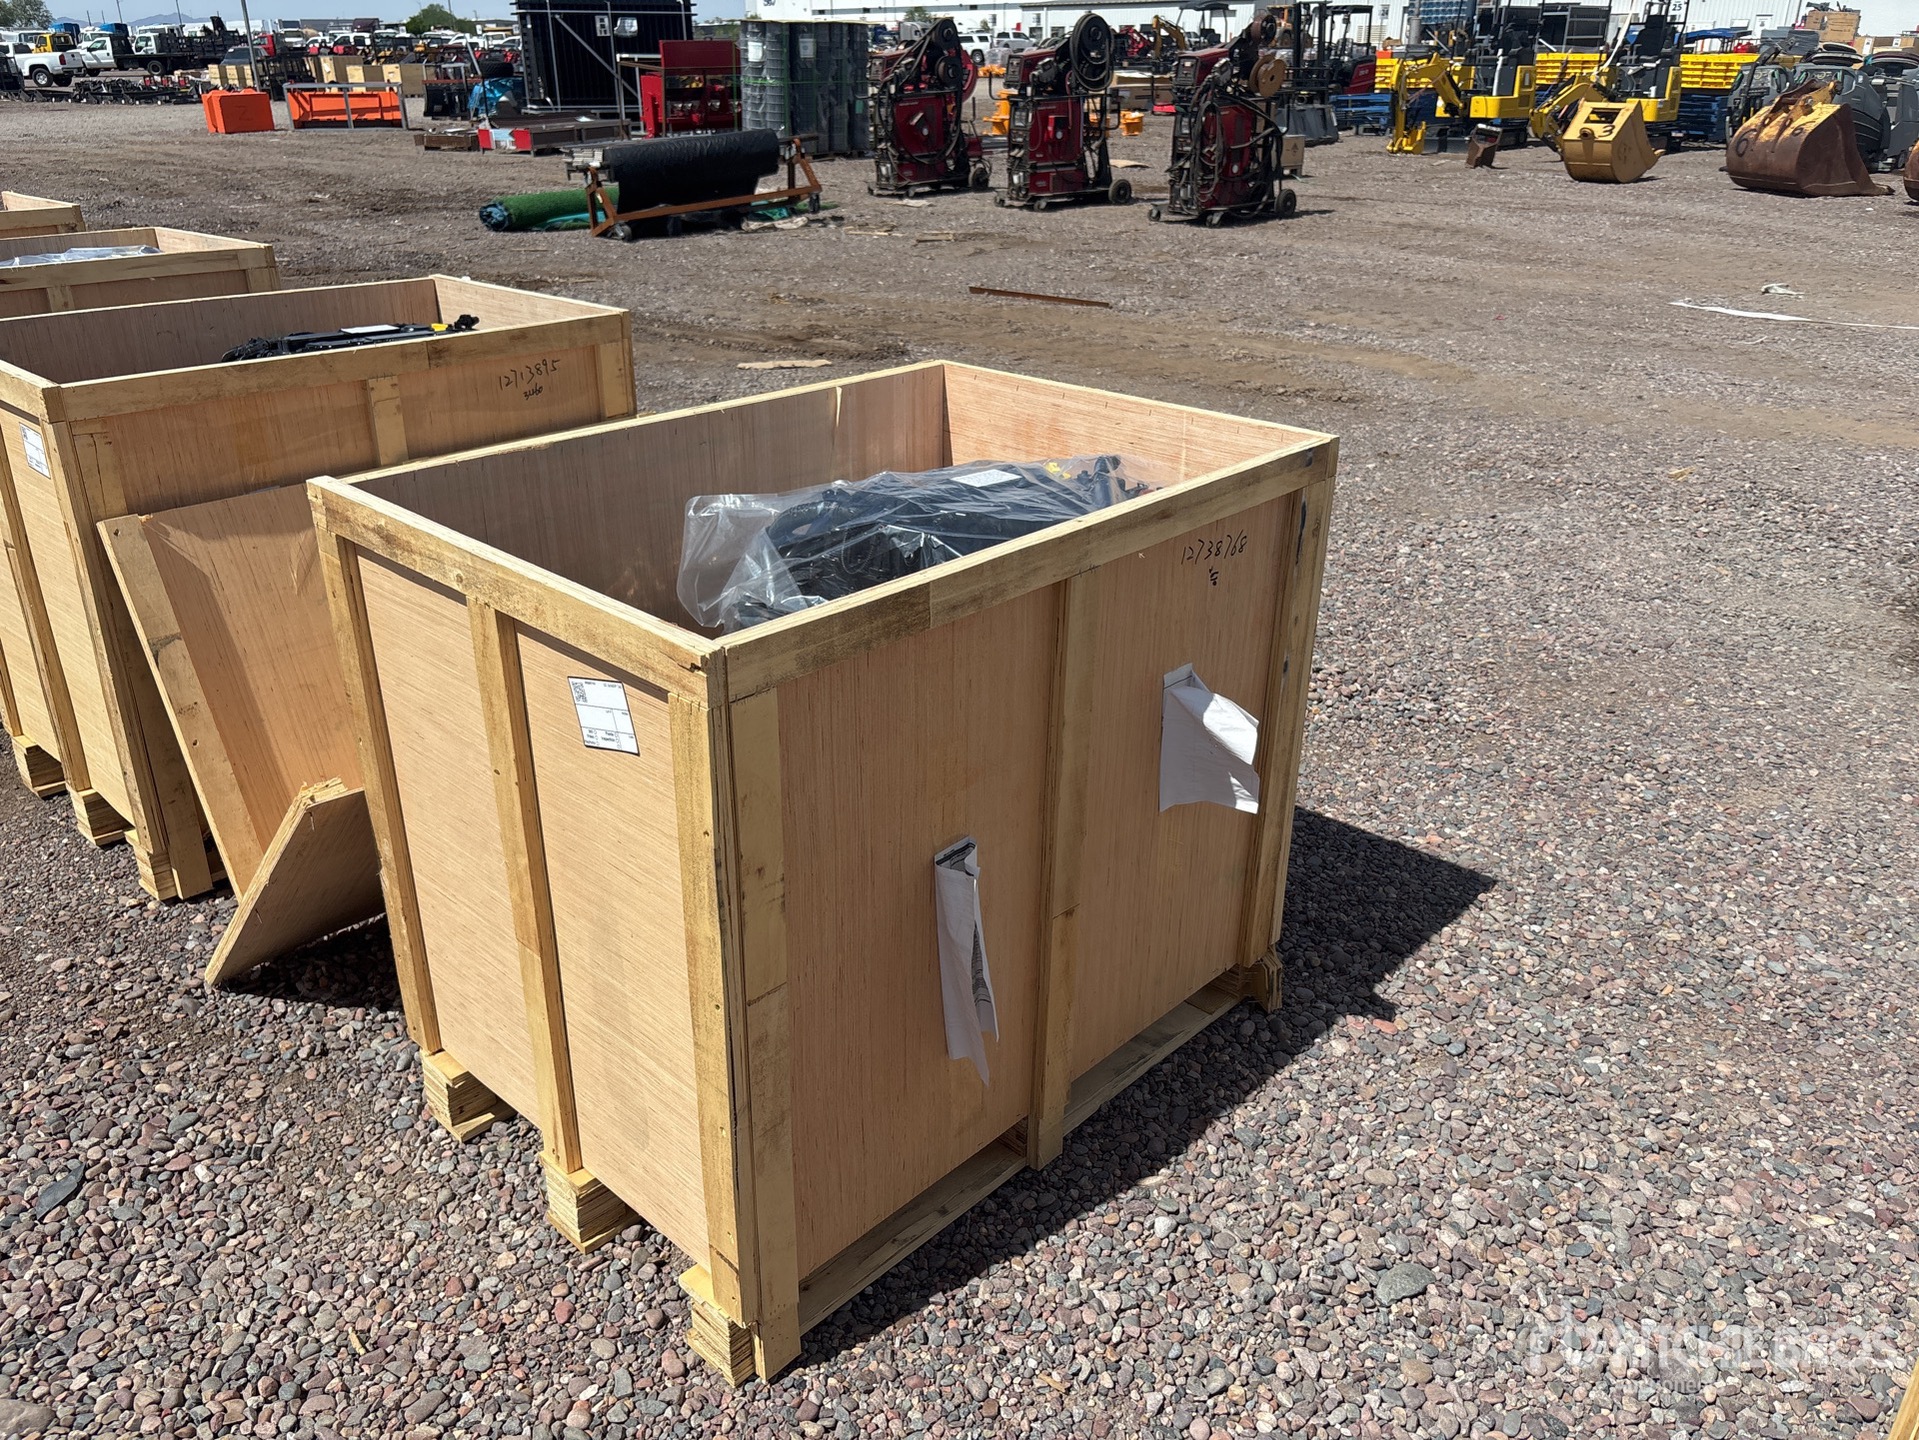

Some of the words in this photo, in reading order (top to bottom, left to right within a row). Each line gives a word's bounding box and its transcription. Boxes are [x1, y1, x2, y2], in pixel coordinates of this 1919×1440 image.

[1671, 3, 1682, 12] 25
[1597, 124, 1616, 138] 3
[1735, 128, 1758, 158] 6
[498, 358, 561, 392] 12713895
[1180, 529, 1248, 565] 12738768
